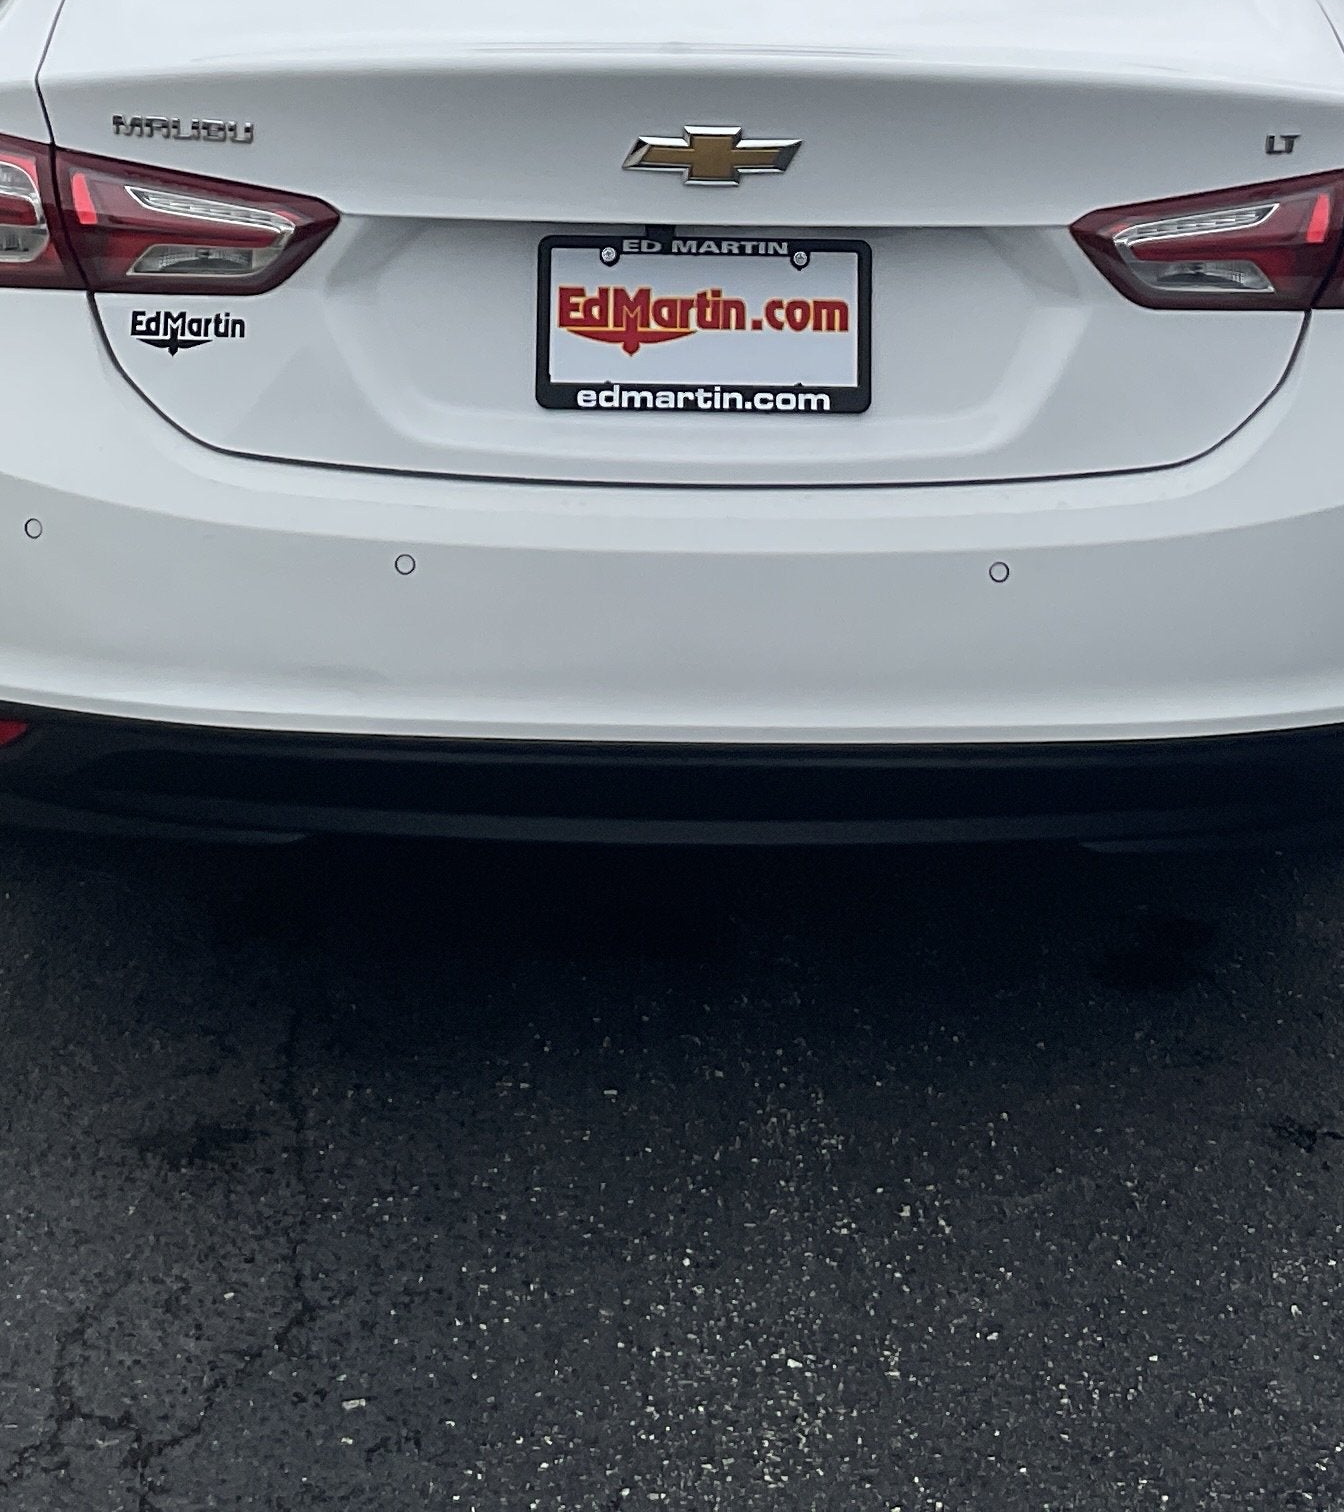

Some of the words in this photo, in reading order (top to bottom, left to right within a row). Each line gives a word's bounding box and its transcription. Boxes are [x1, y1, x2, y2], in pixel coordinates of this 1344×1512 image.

[112, 114, 255, 144] MALIBU
[1265, 133, 1301, 155] LT
[622, 239, 662, 253] ED
[671, 240, 788, 255] MARTIN
[558, 286, 850, 335] EdMartin.com
[130, 310, 245, 341] EdMartin
[576, 386, 831, 411] edmartin.com
